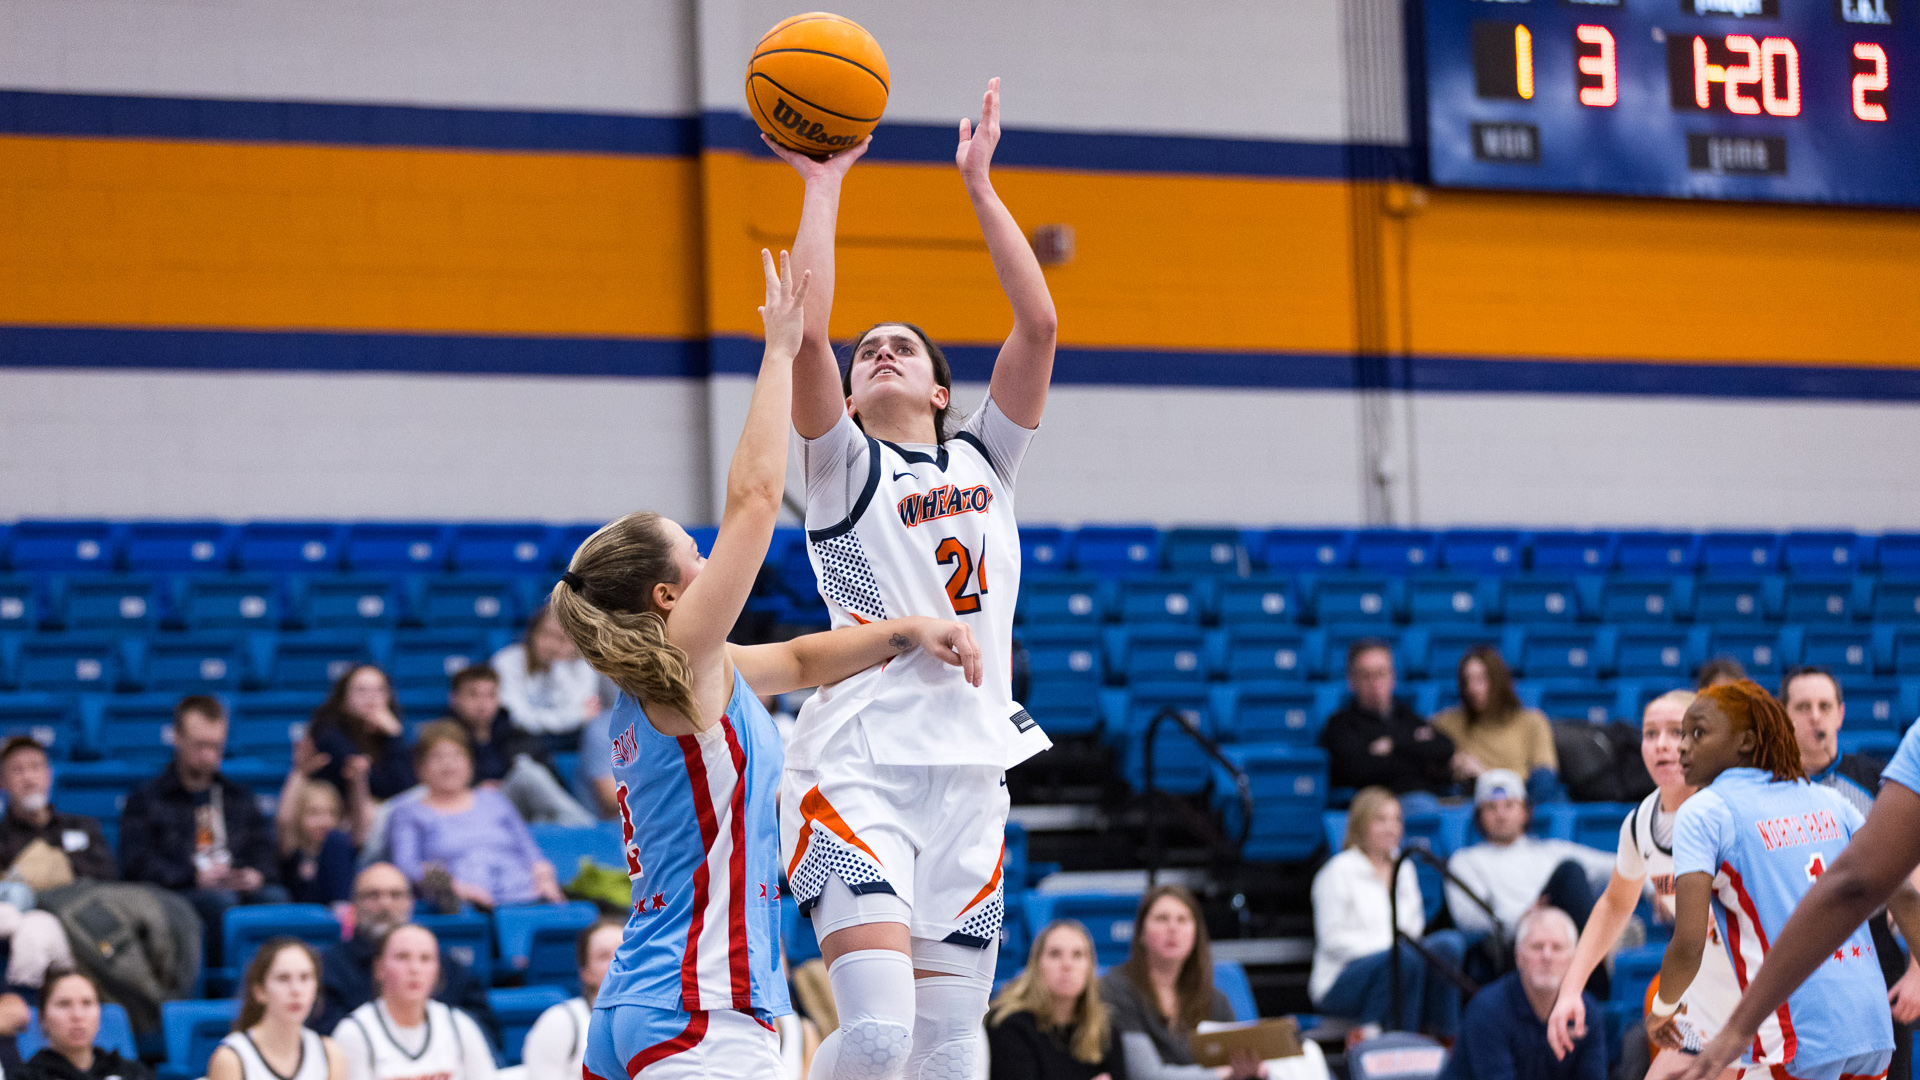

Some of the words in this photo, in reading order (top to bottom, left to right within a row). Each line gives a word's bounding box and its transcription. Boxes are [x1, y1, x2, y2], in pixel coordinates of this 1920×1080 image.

[1515, 24, 1534, 99] 1
[1577, 24, 1618, 107] 3
[1852, 42, 1889, 122] 2
[773, 98, 858, 146] Wilson
[897, 484, 994, 529] WHEATO
[1755, 816, 1808, 852] NORTH
[1802, 809, 1842, 843] PARK
